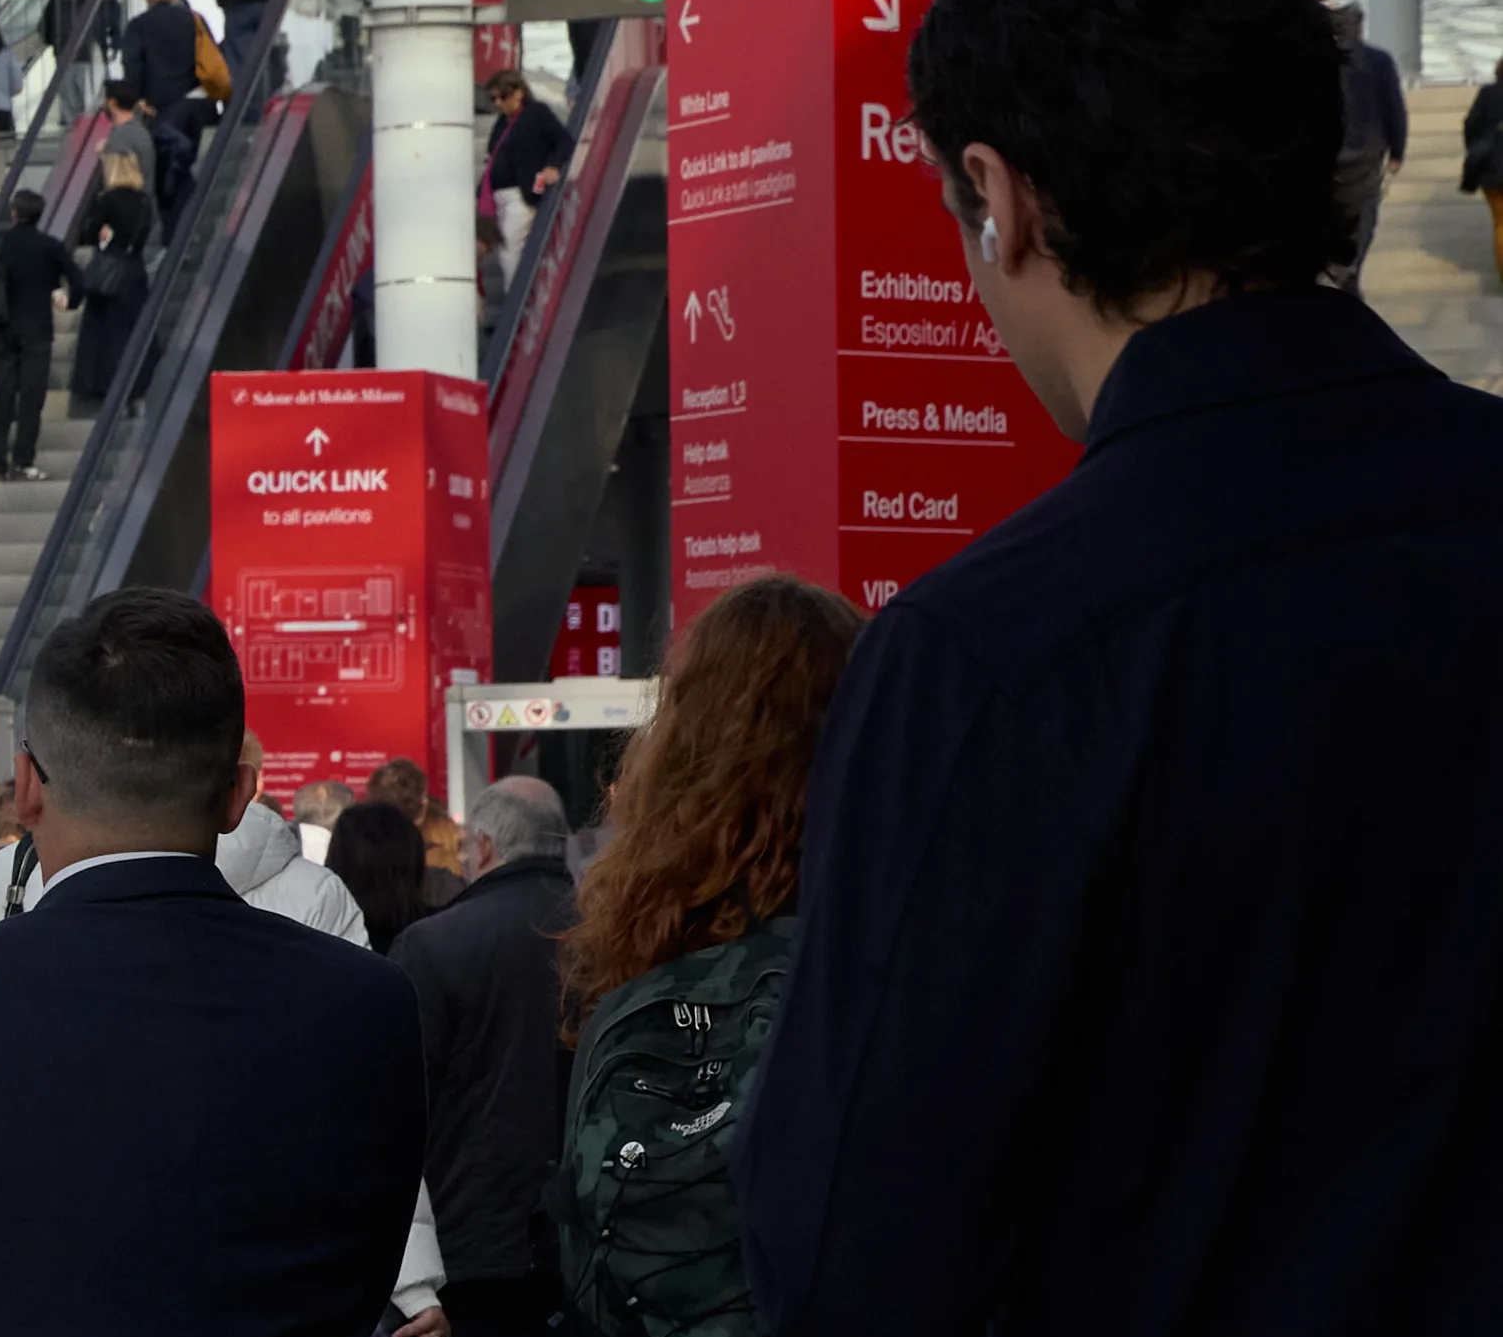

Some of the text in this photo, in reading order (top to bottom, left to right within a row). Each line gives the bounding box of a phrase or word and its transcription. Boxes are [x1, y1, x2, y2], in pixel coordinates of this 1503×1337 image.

[680, 90, 730, 116] White Lane
[861, 102, 920, 163] Re
[861, 271, 975, 302] Exhibitors /
[862, 316, 969, 347] Espositori /
[863, 403, 1007, 434] Press & Media
[248, 469, 388, 495] QUICK LINK
[263, 508, 372, 527] to all pavilions
[864, 492, 958, 521] Red Card
[864, 581, 898, 608] VIP
